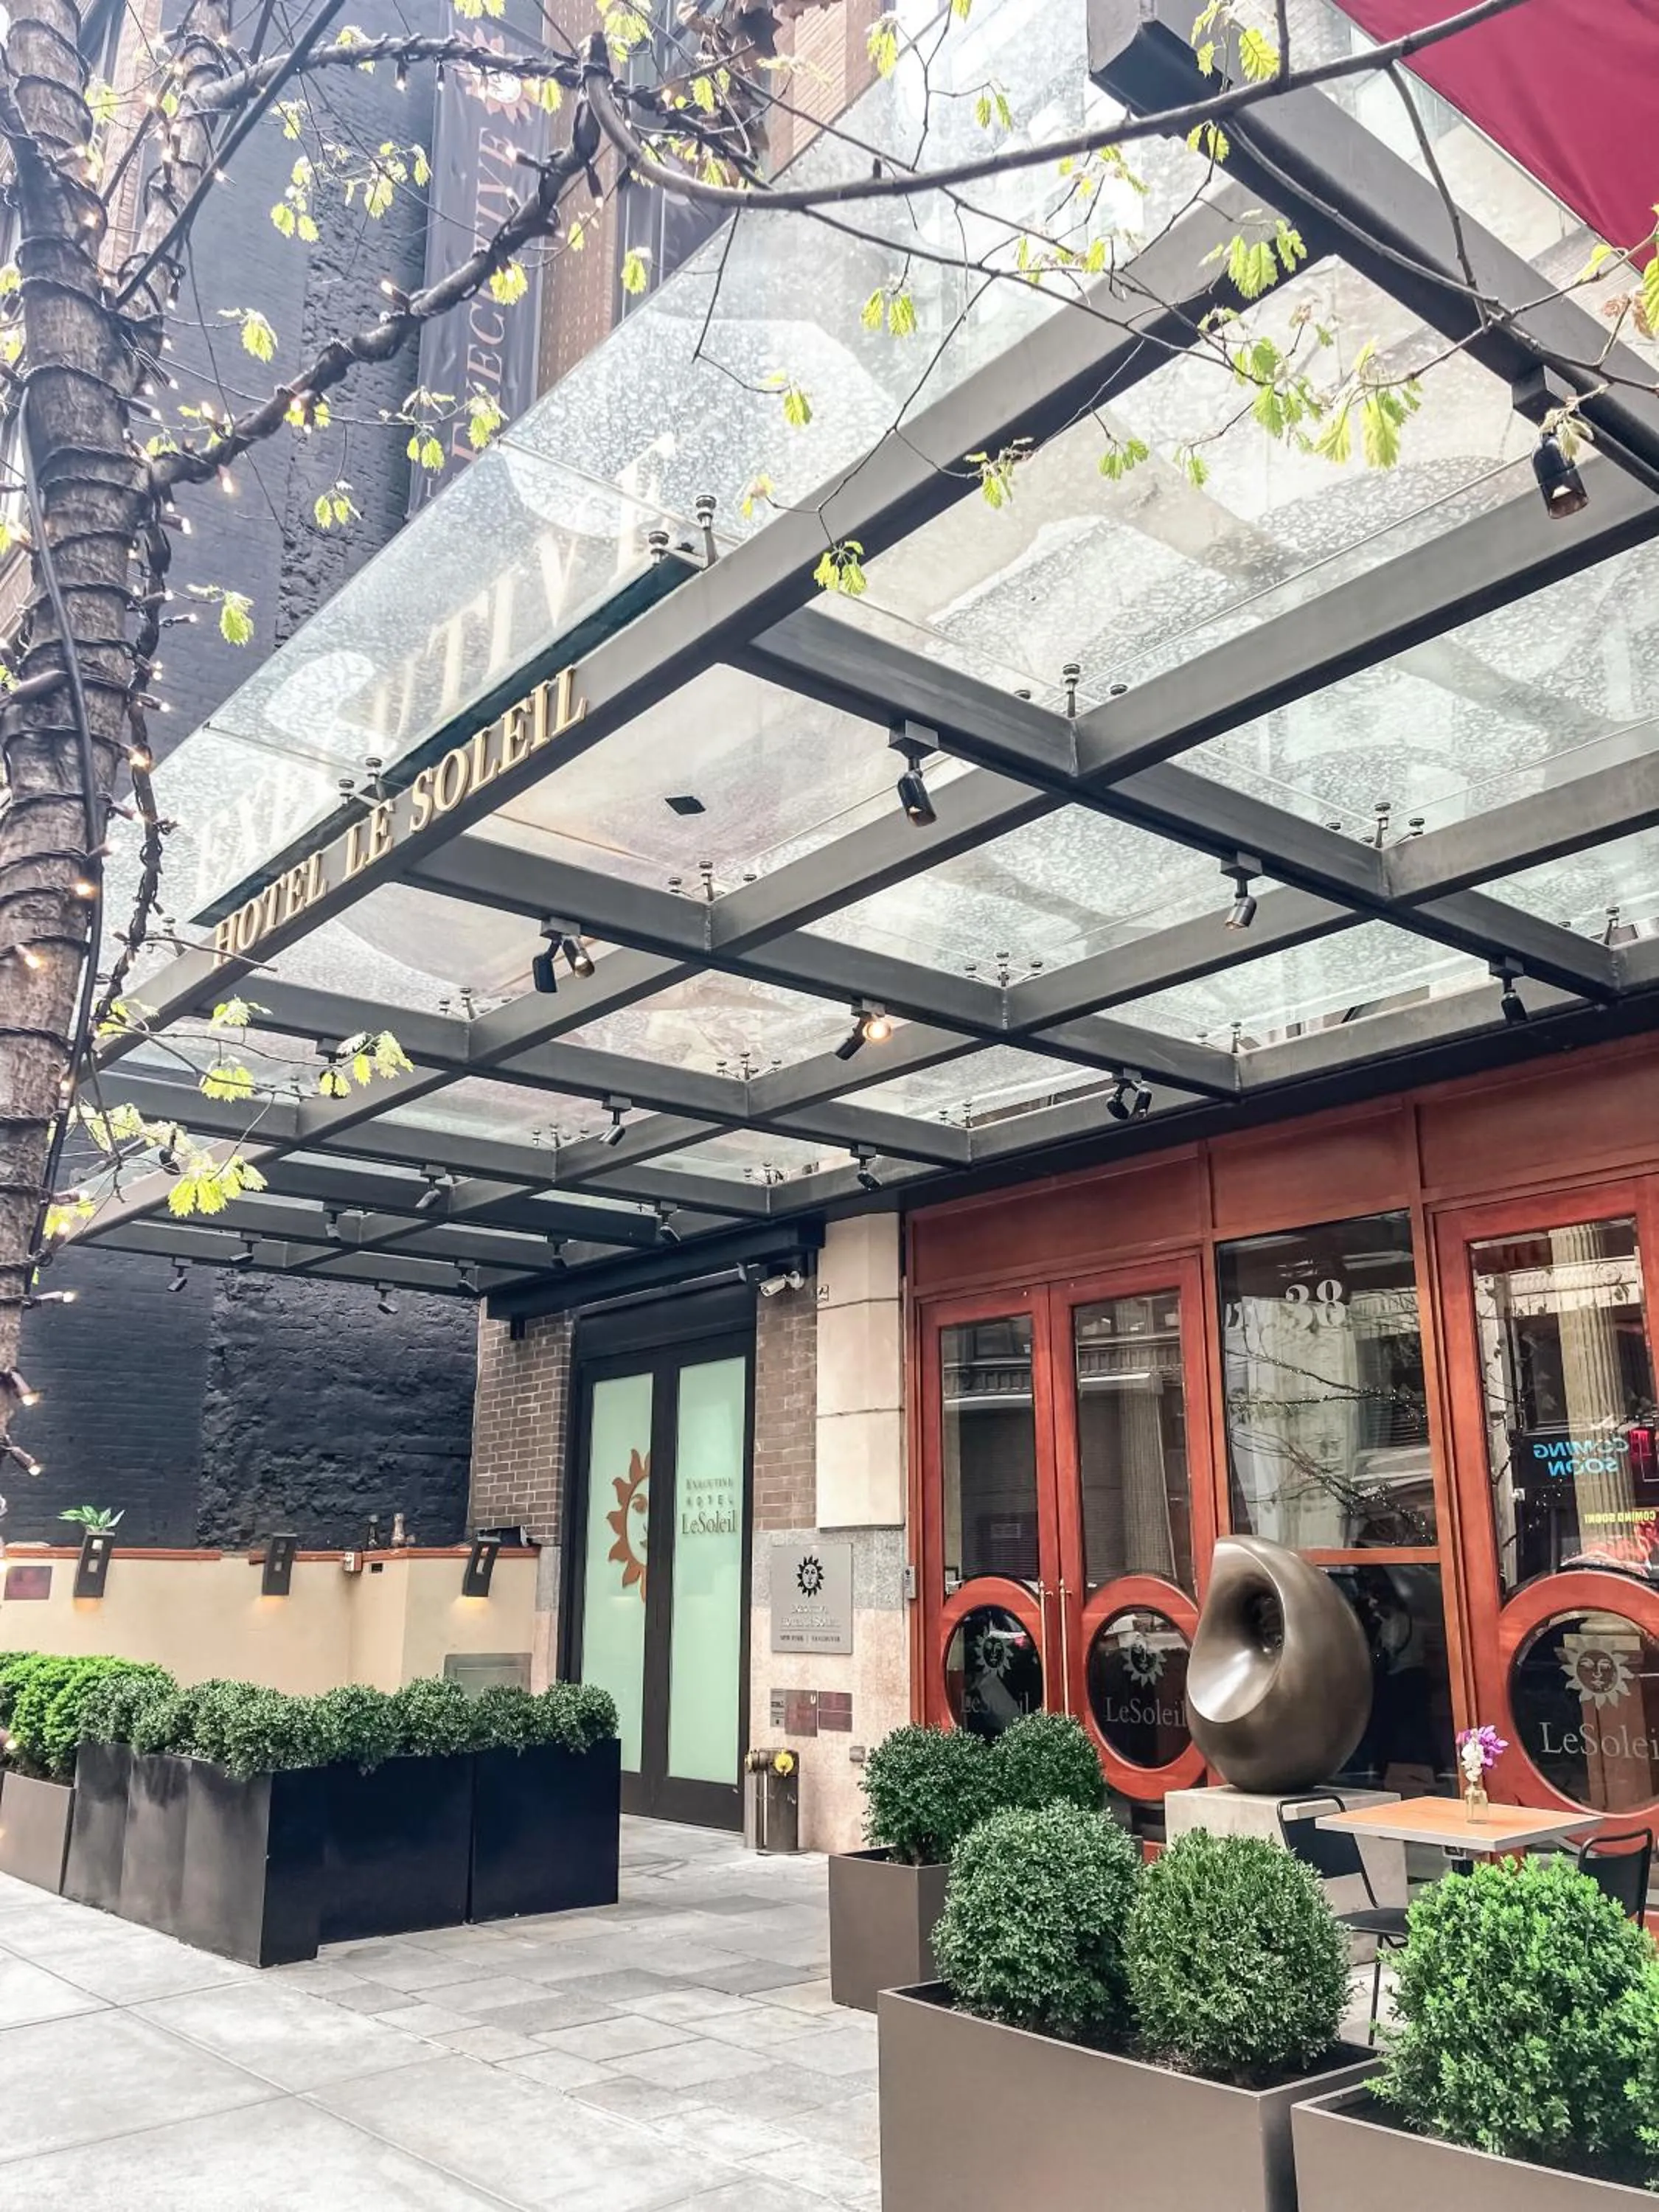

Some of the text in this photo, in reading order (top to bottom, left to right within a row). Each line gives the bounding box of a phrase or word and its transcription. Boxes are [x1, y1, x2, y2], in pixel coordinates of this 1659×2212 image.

[451, 126, 516, 463] EECTIVE
[212, 664, 588, 972] HOTEL LE SOLEIL
[681, 1510, 737, 1534] LeSoleil
[961, 1688, 1030, 1714] LeSil
[1105, 1697, 1186, 1727] LeSoleil
